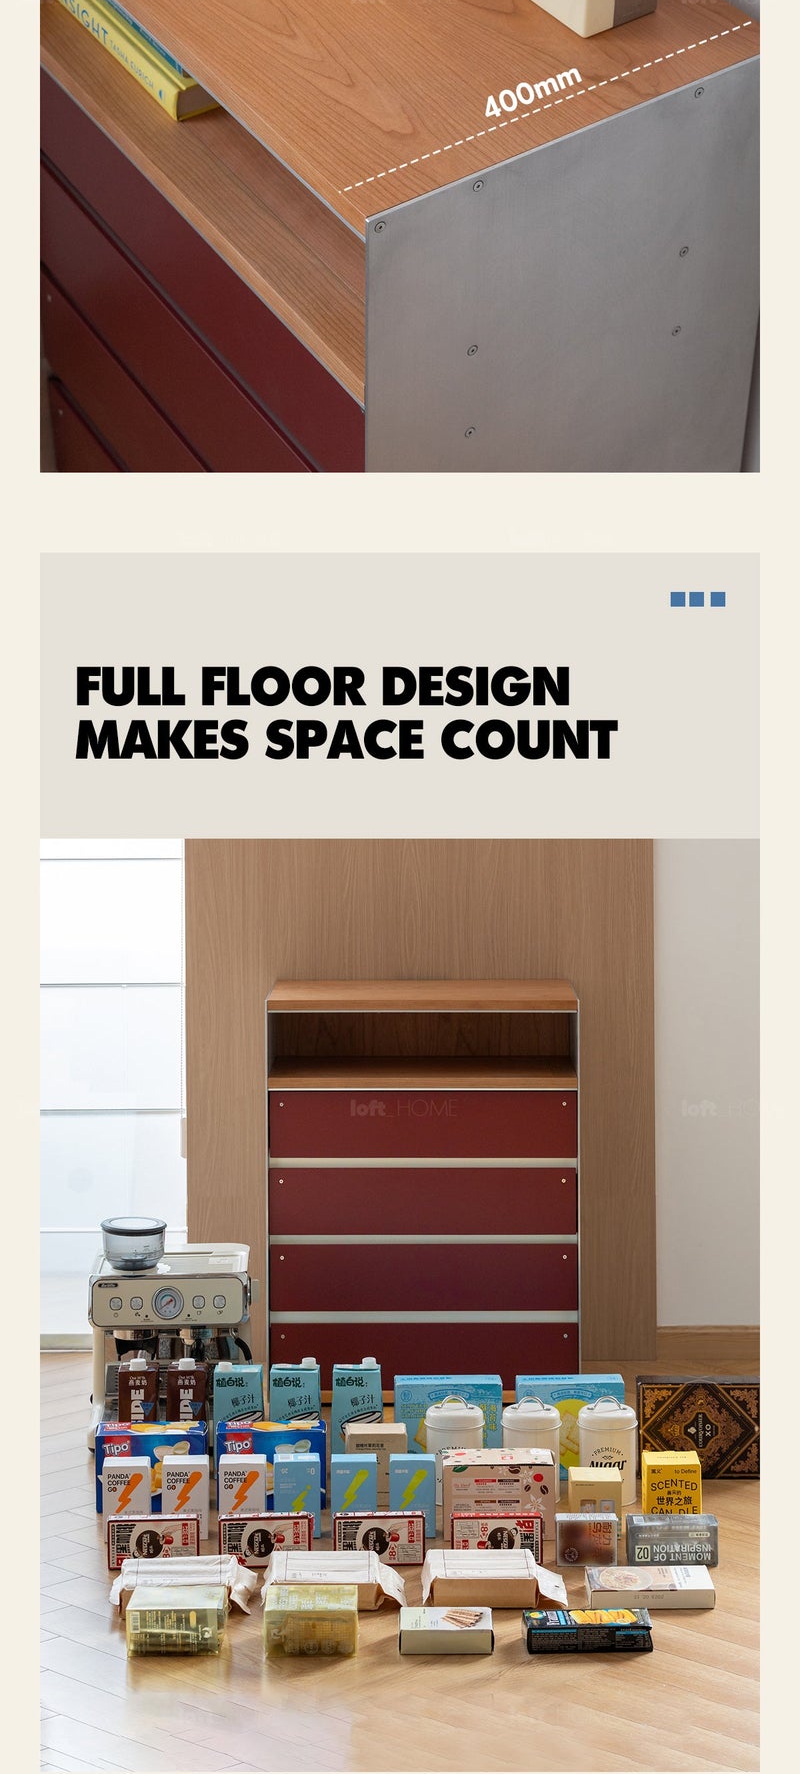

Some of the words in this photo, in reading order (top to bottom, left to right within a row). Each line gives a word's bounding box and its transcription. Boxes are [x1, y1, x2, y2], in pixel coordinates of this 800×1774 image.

[231, 1394, 254, 1407] 椰子汁
[287, 1394, 312, 1407] 椰子汁
[350, 1394, 374, 1407] 椰子汁
[103, 1444, 129, 1457] Tipo
[224, 1443, 251, 1454] Tipo
[593, 1447, 622, 1456] PREMIUM
[650, 1478, 698, 1491] SCENTED
[656, 1496, 692, 1506] 世界之旅
[637, 1547, 649, 1560] 02
[653, 1543, 711, 1552] INSPIRATION
[654, 1553, 667, 1561] OF
[669, 1553, 711, 1561] MOMENT
